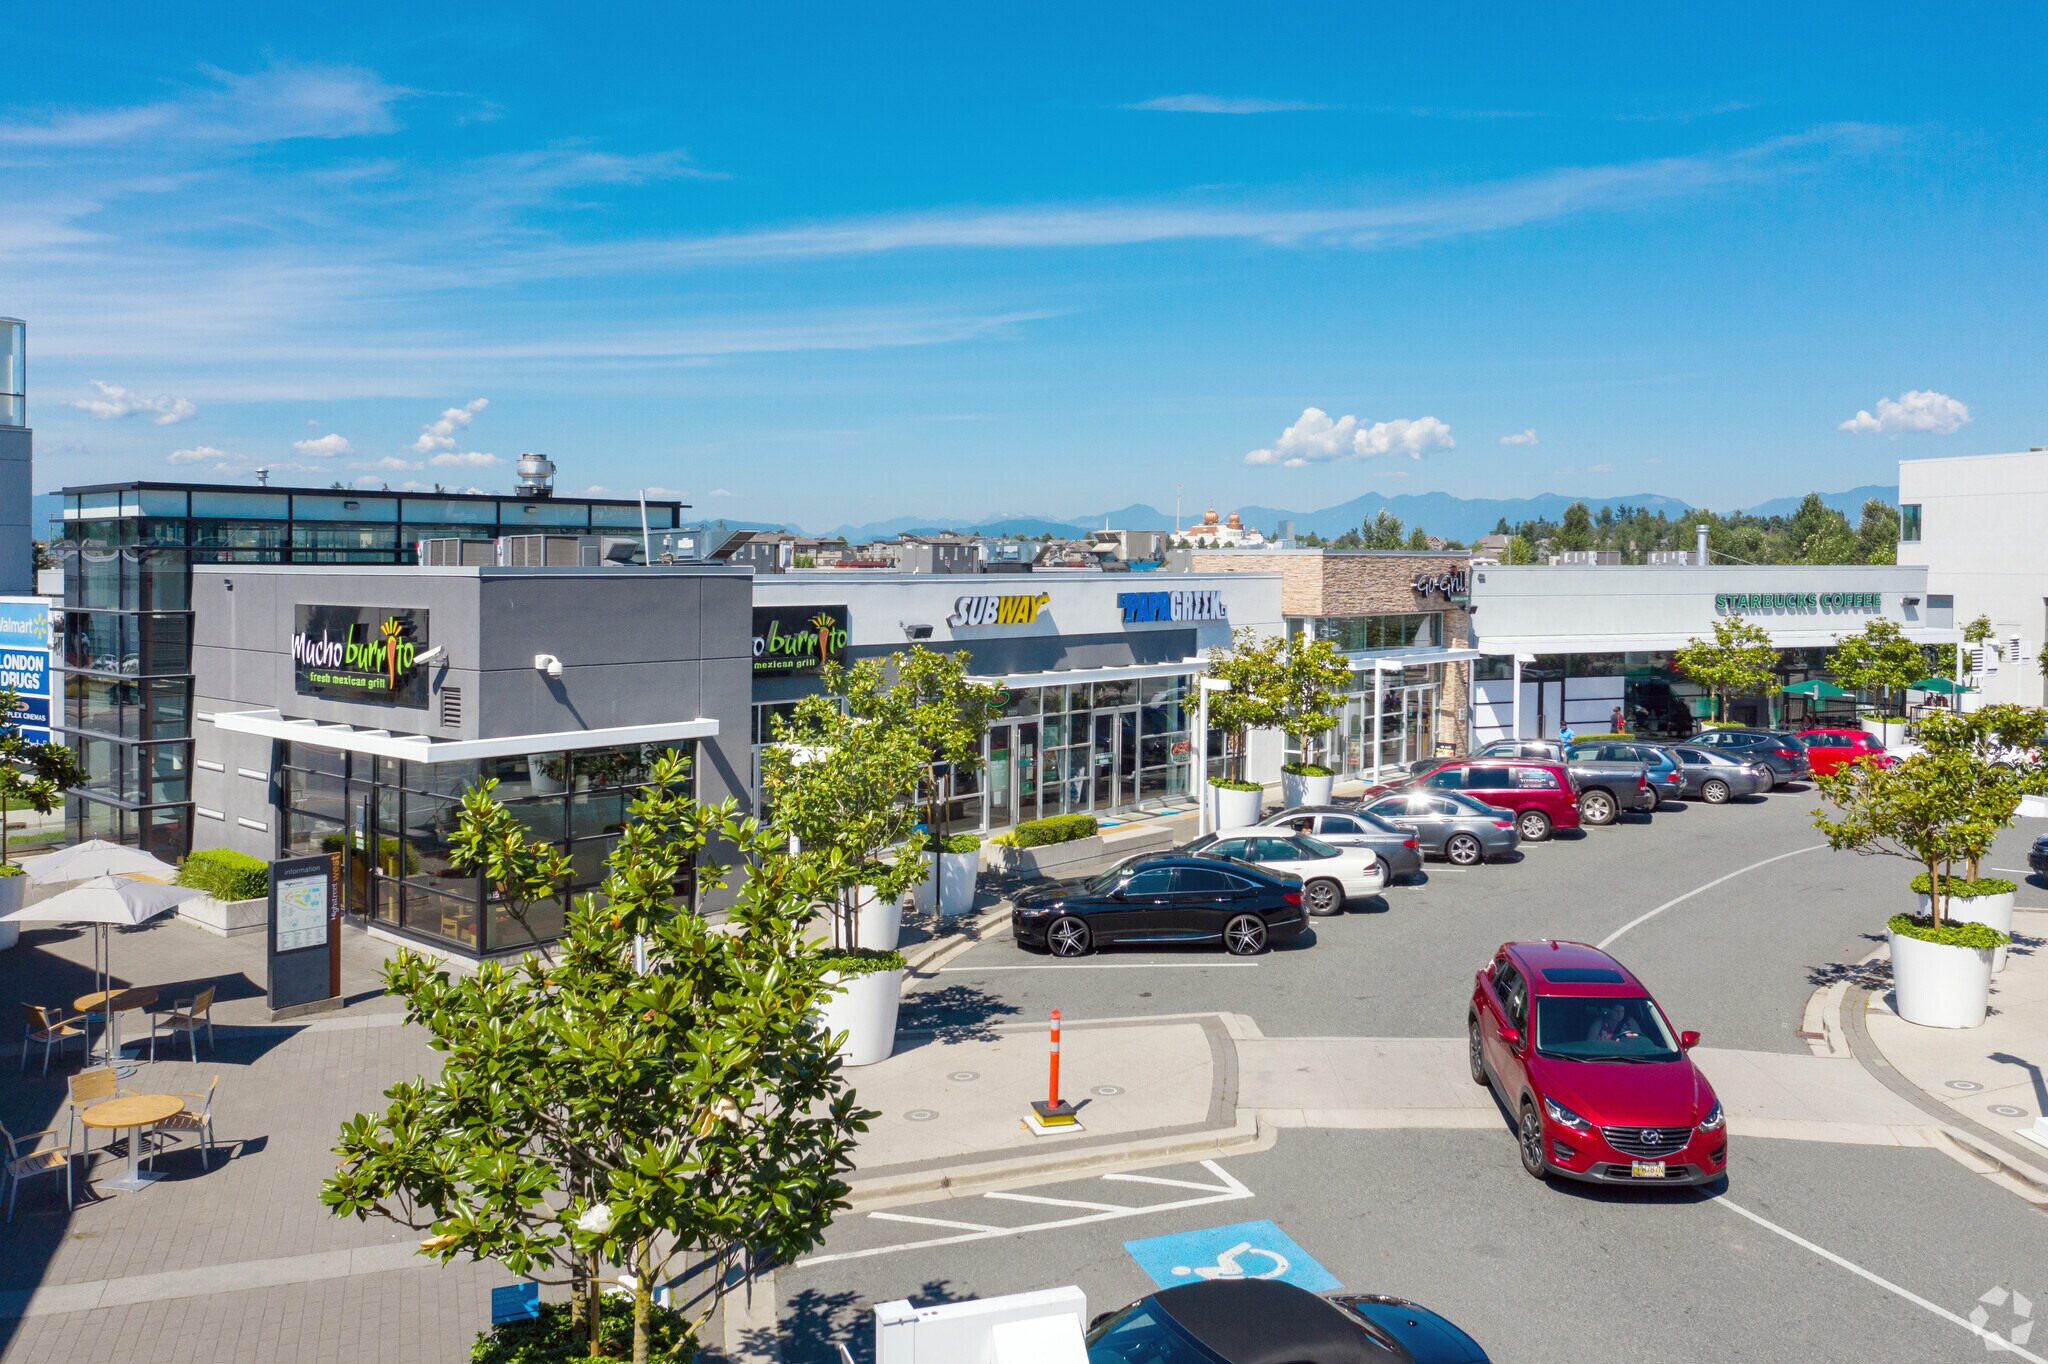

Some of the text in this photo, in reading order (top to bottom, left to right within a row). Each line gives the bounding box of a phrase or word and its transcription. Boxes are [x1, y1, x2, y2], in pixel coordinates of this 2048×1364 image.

[948, 592, 1050, 628] SUBWAY
[1716, 593, 1882, 609] STARBUCKS COFFEE
[768, 613, 848, 660] burrito
[292, 617, 415, 685] Mucho burrito
[754, 659, 815, 669] mexican grill
[1, 670, 41, 690] DRUGS
[310, 671, 386, 690] fresh mexican grill
[22, 712, 46, 721] CINEMAS
[284, 865, 320, 876] information
[331, 855, 340, 881] west
